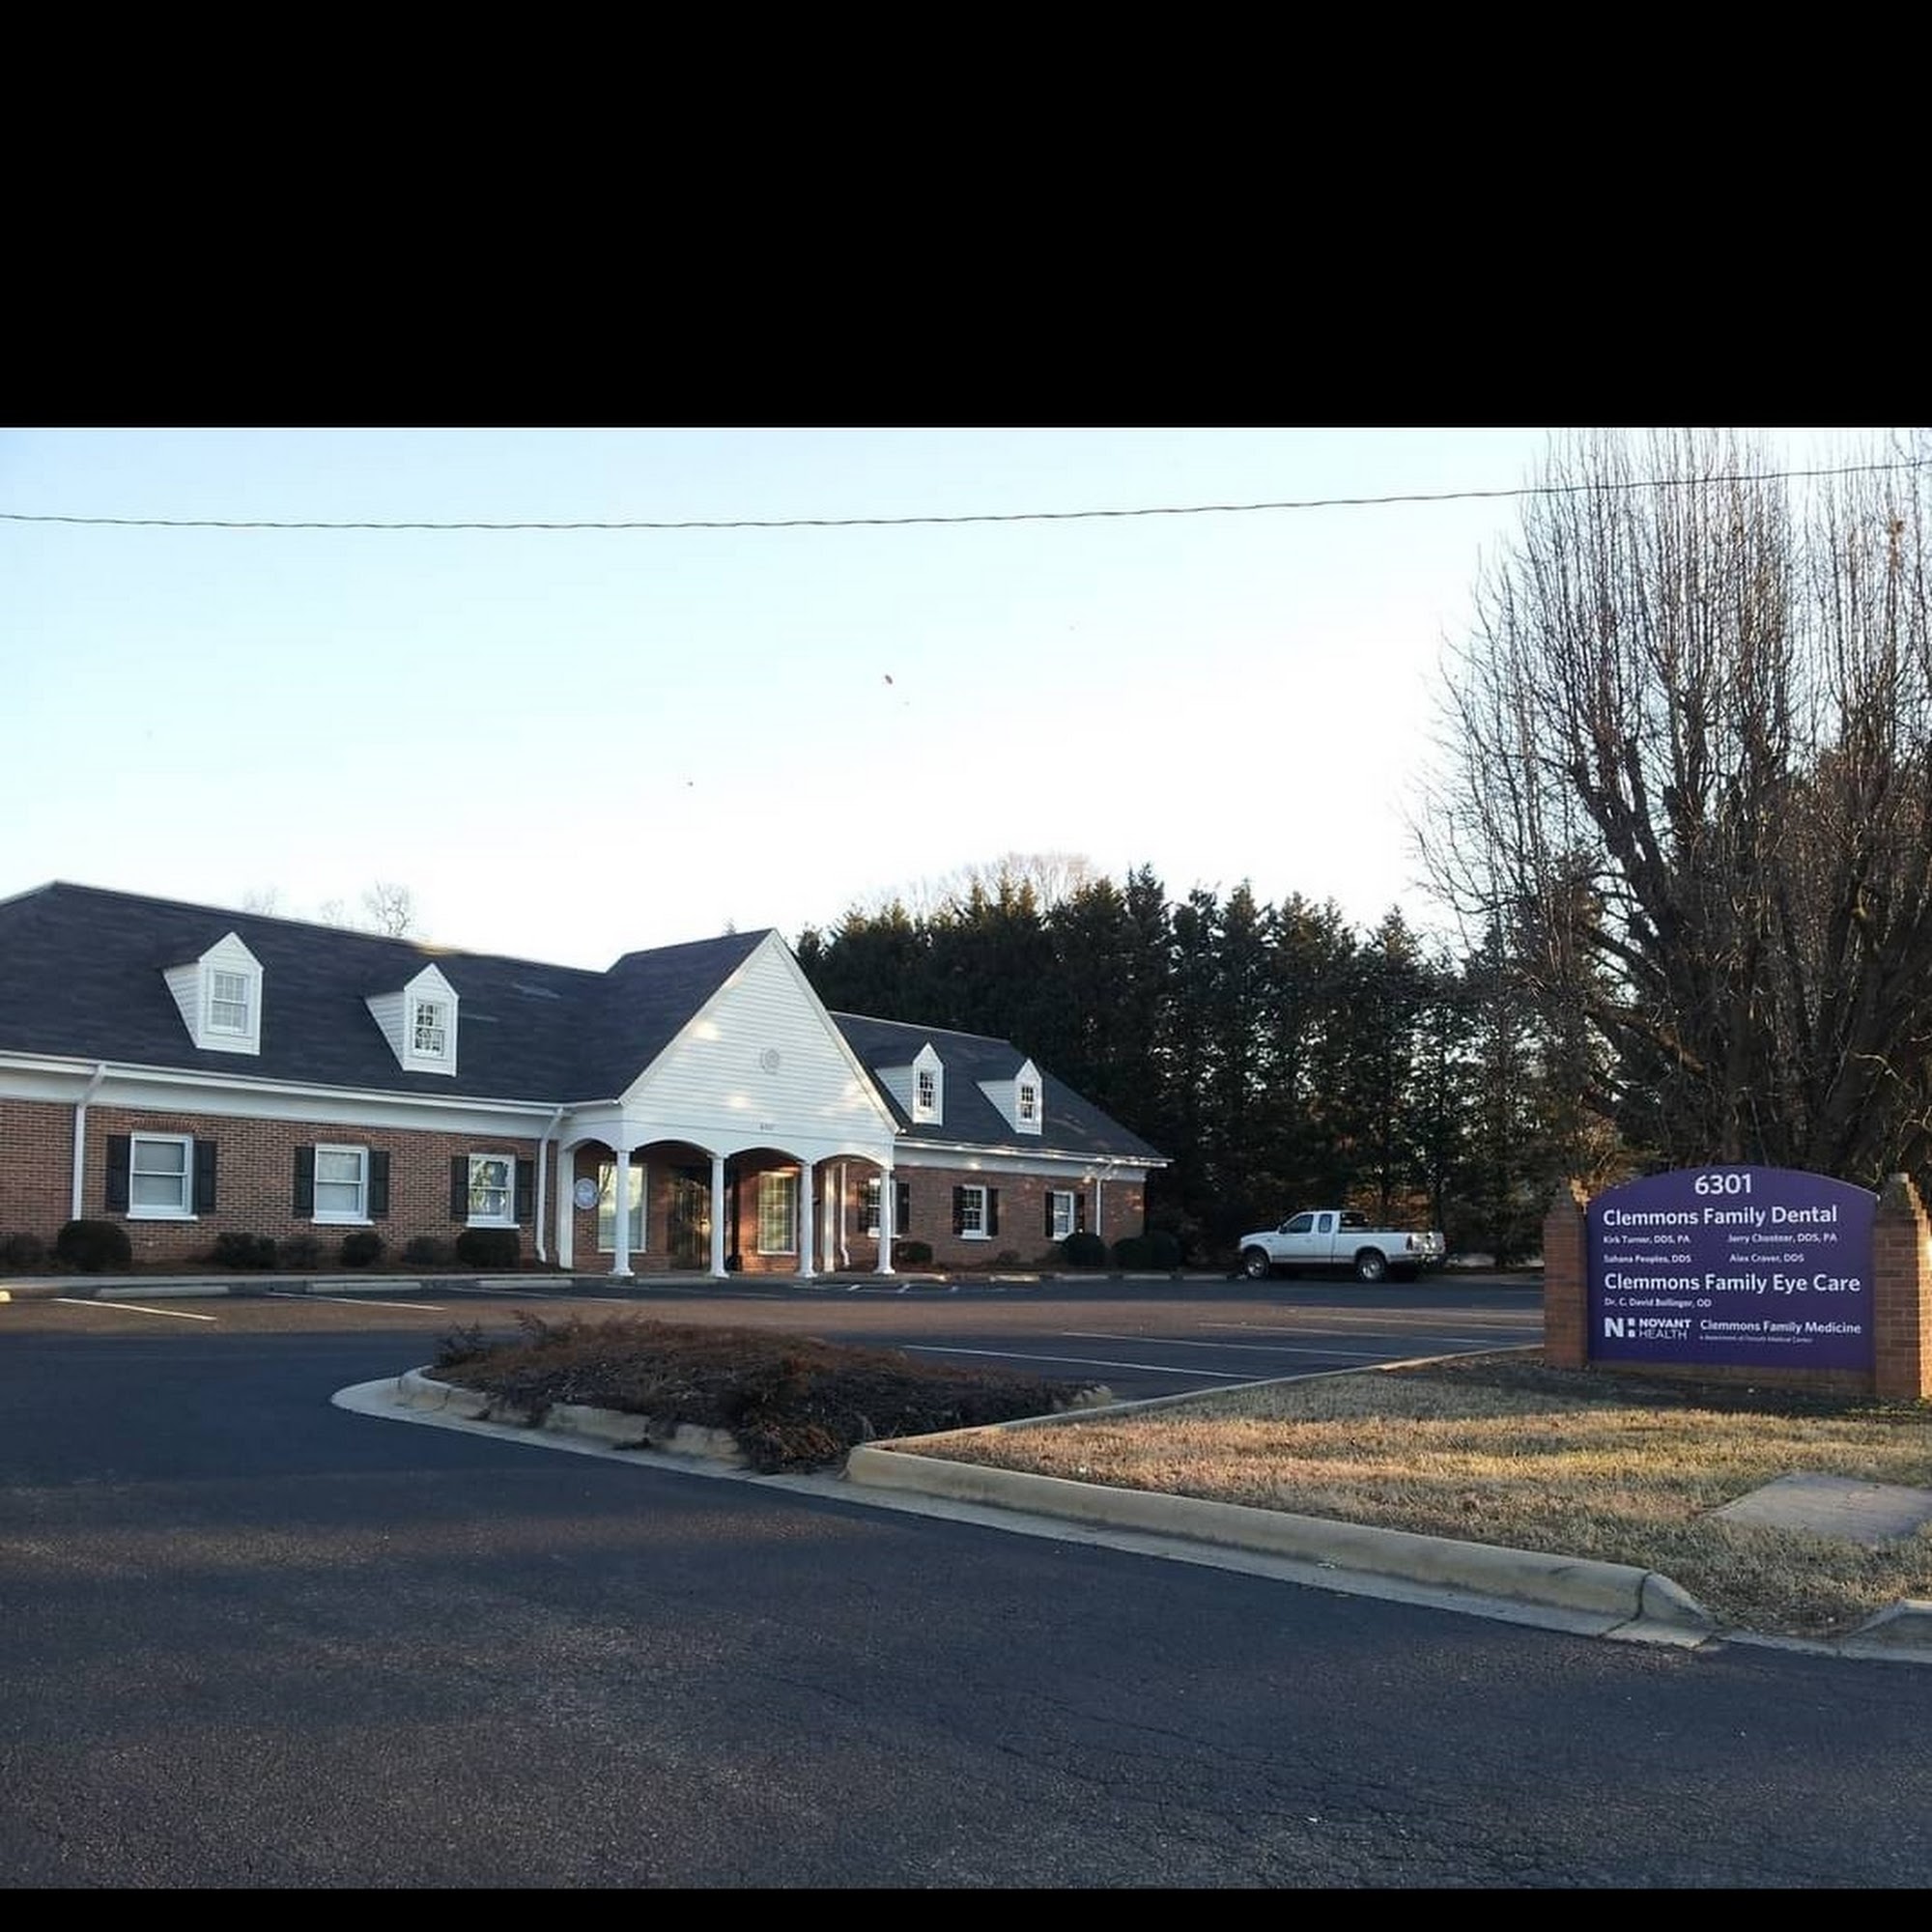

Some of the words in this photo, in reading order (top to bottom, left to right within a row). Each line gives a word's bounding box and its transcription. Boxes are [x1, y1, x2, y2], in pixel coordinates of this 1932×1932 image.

[1694, 1174, 1751, 1194] 6301
[1603, 1209, 1699, 1226] Clemmons
[1704, 1208, 1766, 1227] Family
[1772, 1205, 1837, 1224] Dental
[1677, 1235, 1690, 1244] PA
[1823, 1233, 1837, 1243] PA
[1671, 1255, 1691, 1264] DDS
[1783, 1253, 1804, 1263] DDS
[1604, 1273, 1700, 1291] Clemmons
[1705, 1273, 1768, 1294] Family
[1773, 1274, 1808, 1294] Eye
[1813, 1274, 1861, 1292] Care
[1639, 1318, 1691, 1328] NOVANT
[1700, 1320, 1761, 1331] Clemmons
[1763, 1321, 1803, 1334] Family
[1804, 1321, 1861, 1334] Medicine
[1639, 1329, 1689, 1340] HEALTH
